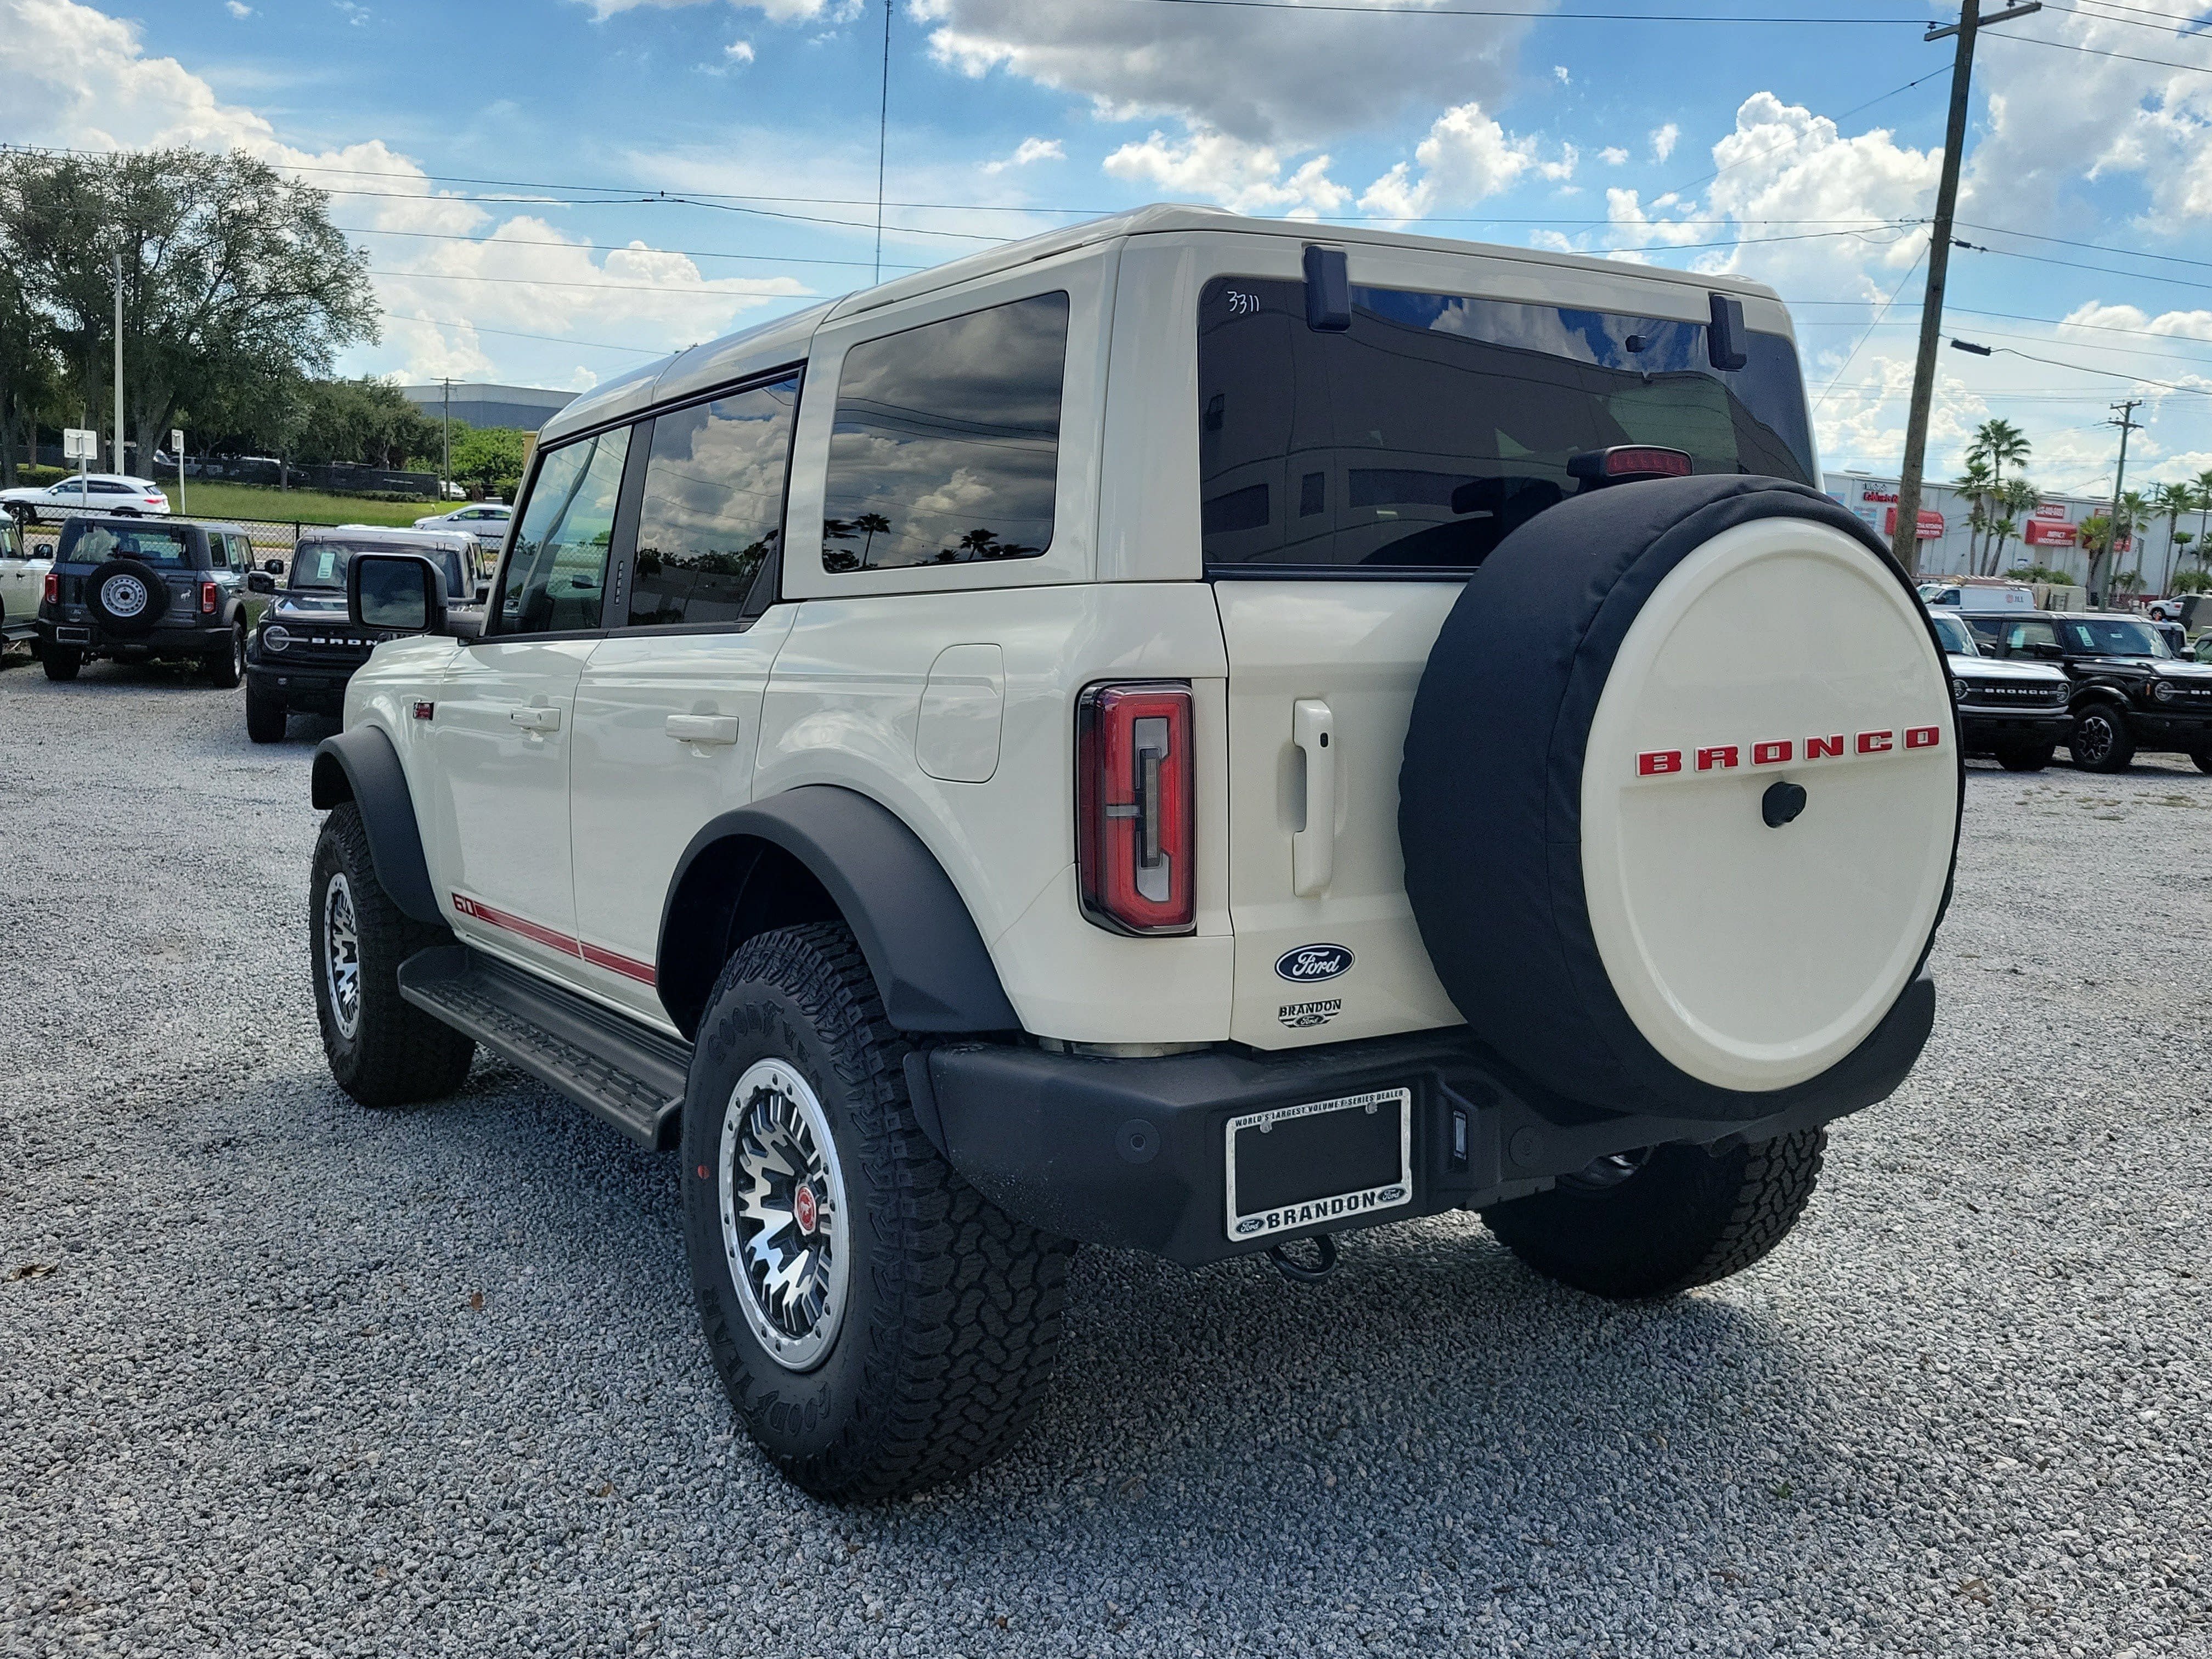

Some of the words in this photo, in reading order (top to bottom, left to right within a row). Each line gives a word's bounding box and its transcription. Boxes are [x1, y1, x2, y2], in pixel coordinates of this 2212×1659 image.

[1227, 290, 1260, 314] 3311
[312, 637, 378, 646] BRON
[1635, 724, 1940, 777] BRONCO
[451, 892, 478, 918] 60
[1292, 951, 1341, 976] Ford
[1279, 998, 1342, 1017] BRANDON
[1300, 1015, 1318, 1025] Ford
[1235, 1113, 1269, 1127] WORLD'S
[1271, 1107, 1306, 1120] LARGEST
[1308, 1101, 1338, 1113] VOLUME
[1340, 1094, 1374, 1107] F-SERIES
[1376, 1090, 1403, 1101] DEALER
[1240, 1219, 1261, 1233] Ford
[1266, 1191, 1376, 1229] BRANDON
[1382, 1188, 1401, 1201] Ford
